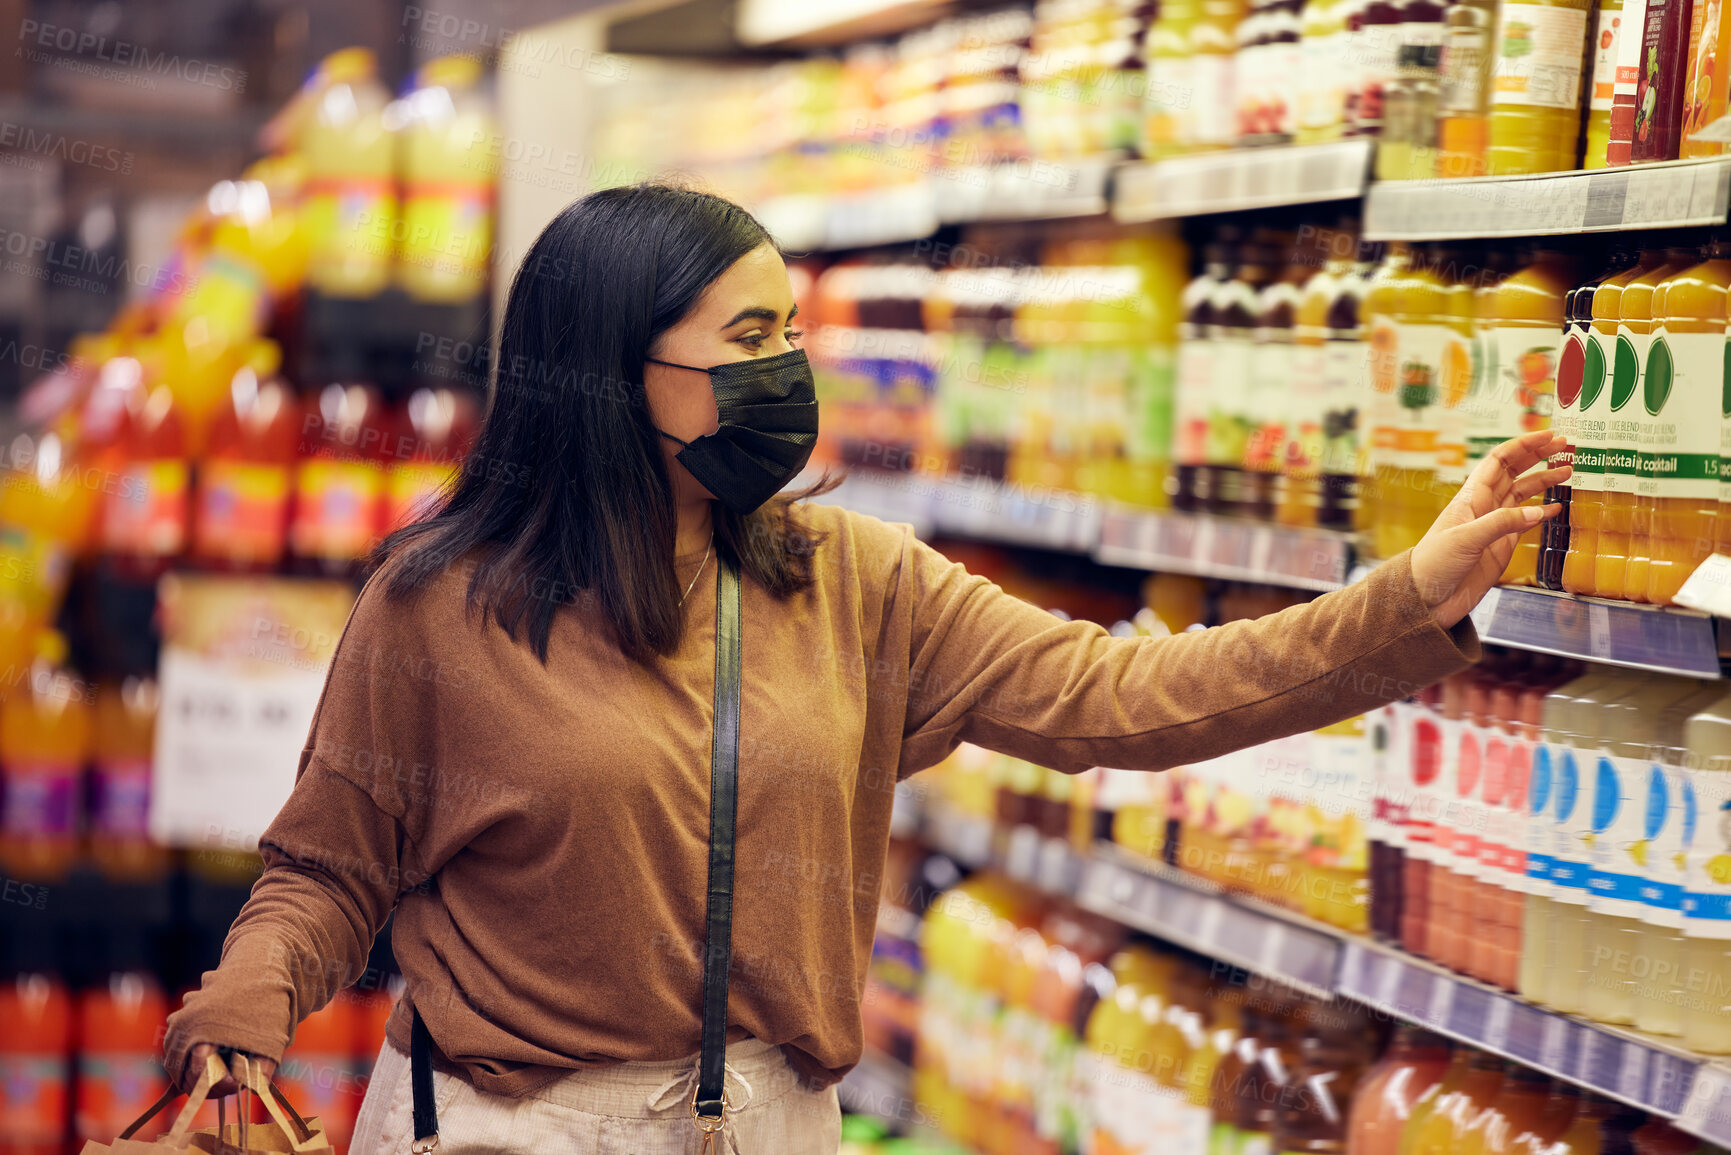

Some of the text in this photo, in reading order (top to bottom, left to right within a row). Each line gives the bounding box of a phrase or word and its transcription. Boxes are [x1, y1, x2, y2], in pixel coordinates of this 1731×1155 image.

[1588, 420, 1606, 431] BLEND
[1621, 420, 1640, 432] BLEND
[1704, 459, 1718, 475] 1.5
